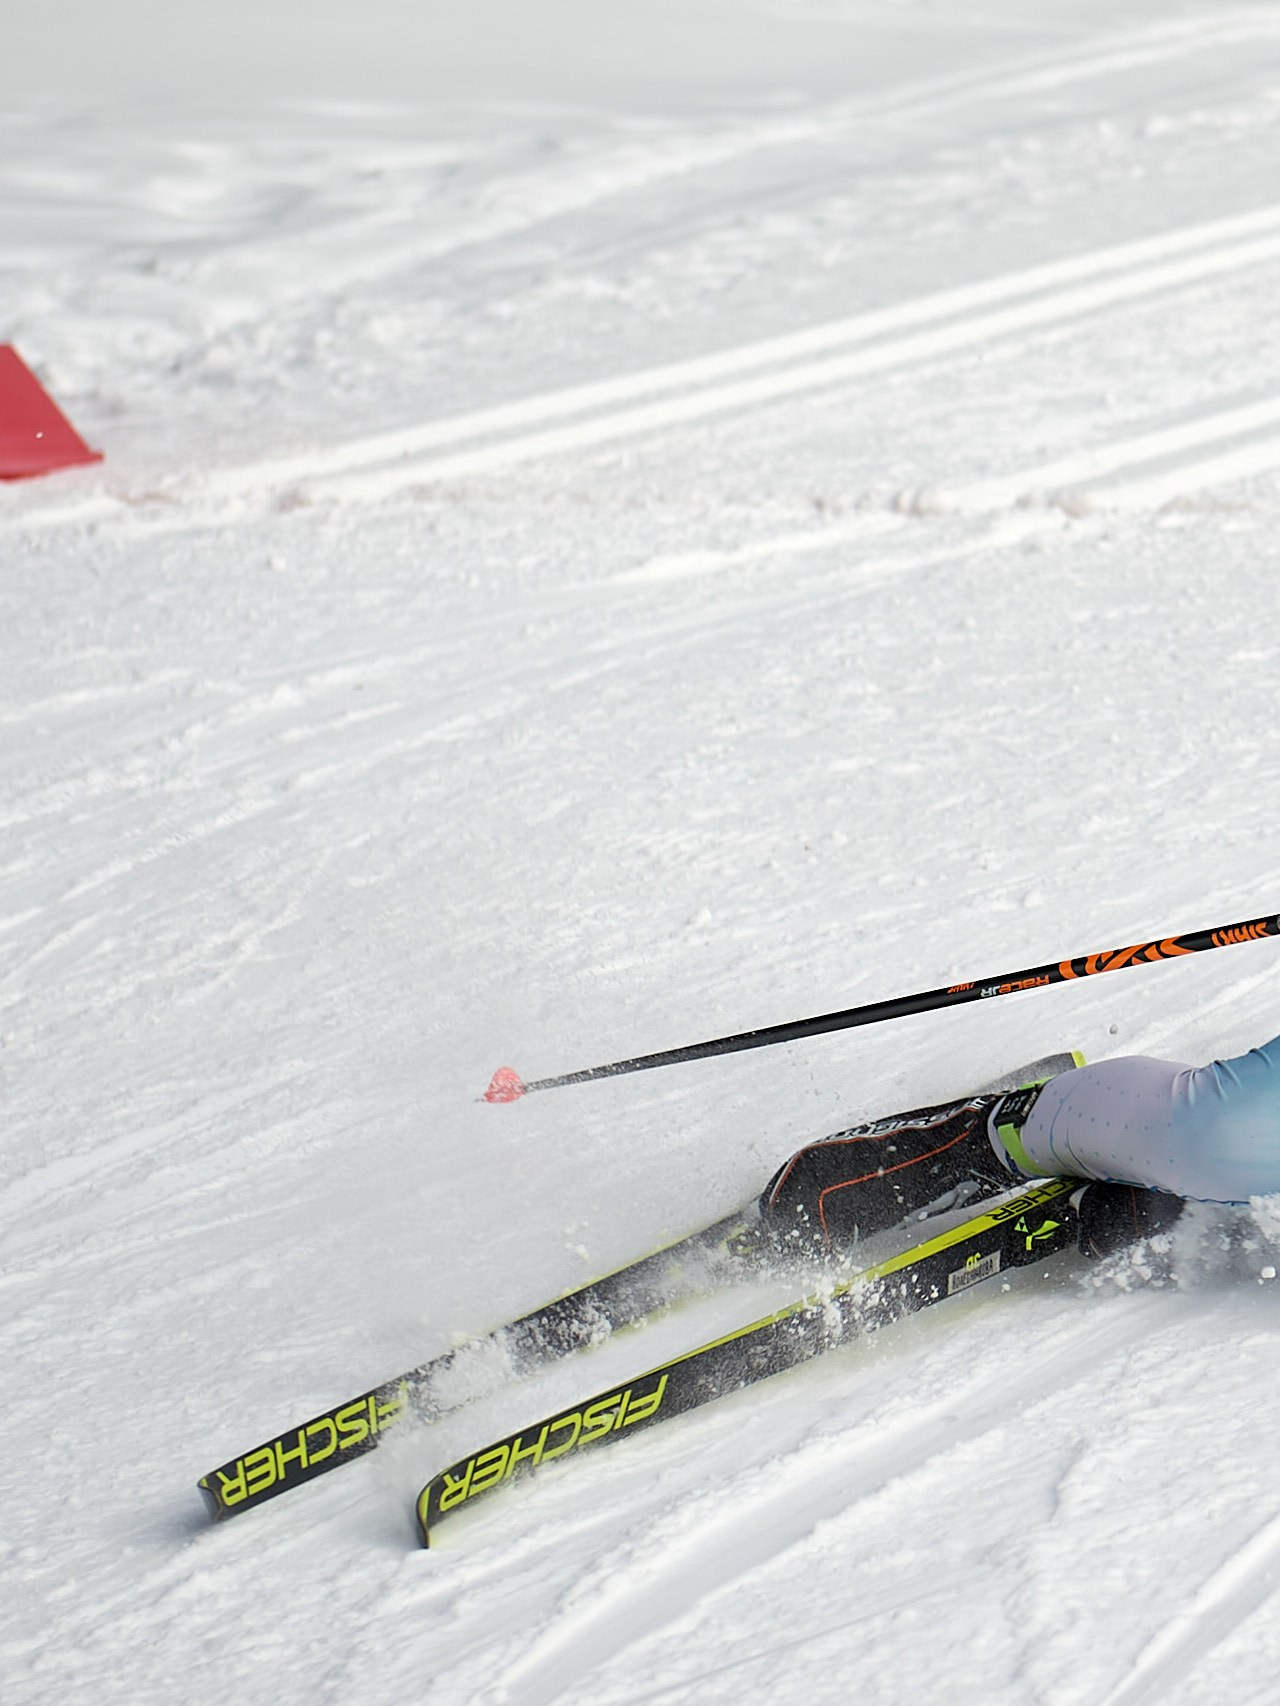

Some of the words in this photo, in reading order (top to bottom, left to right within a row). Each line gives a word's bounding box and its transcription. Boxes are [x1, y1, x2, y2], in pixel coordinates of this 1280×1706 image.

[985, 1180, 1068, 1221] CHER
[216, 1380, 408, 1506] FISCHER
[438, 1374, 669, 1512] FISCHER
